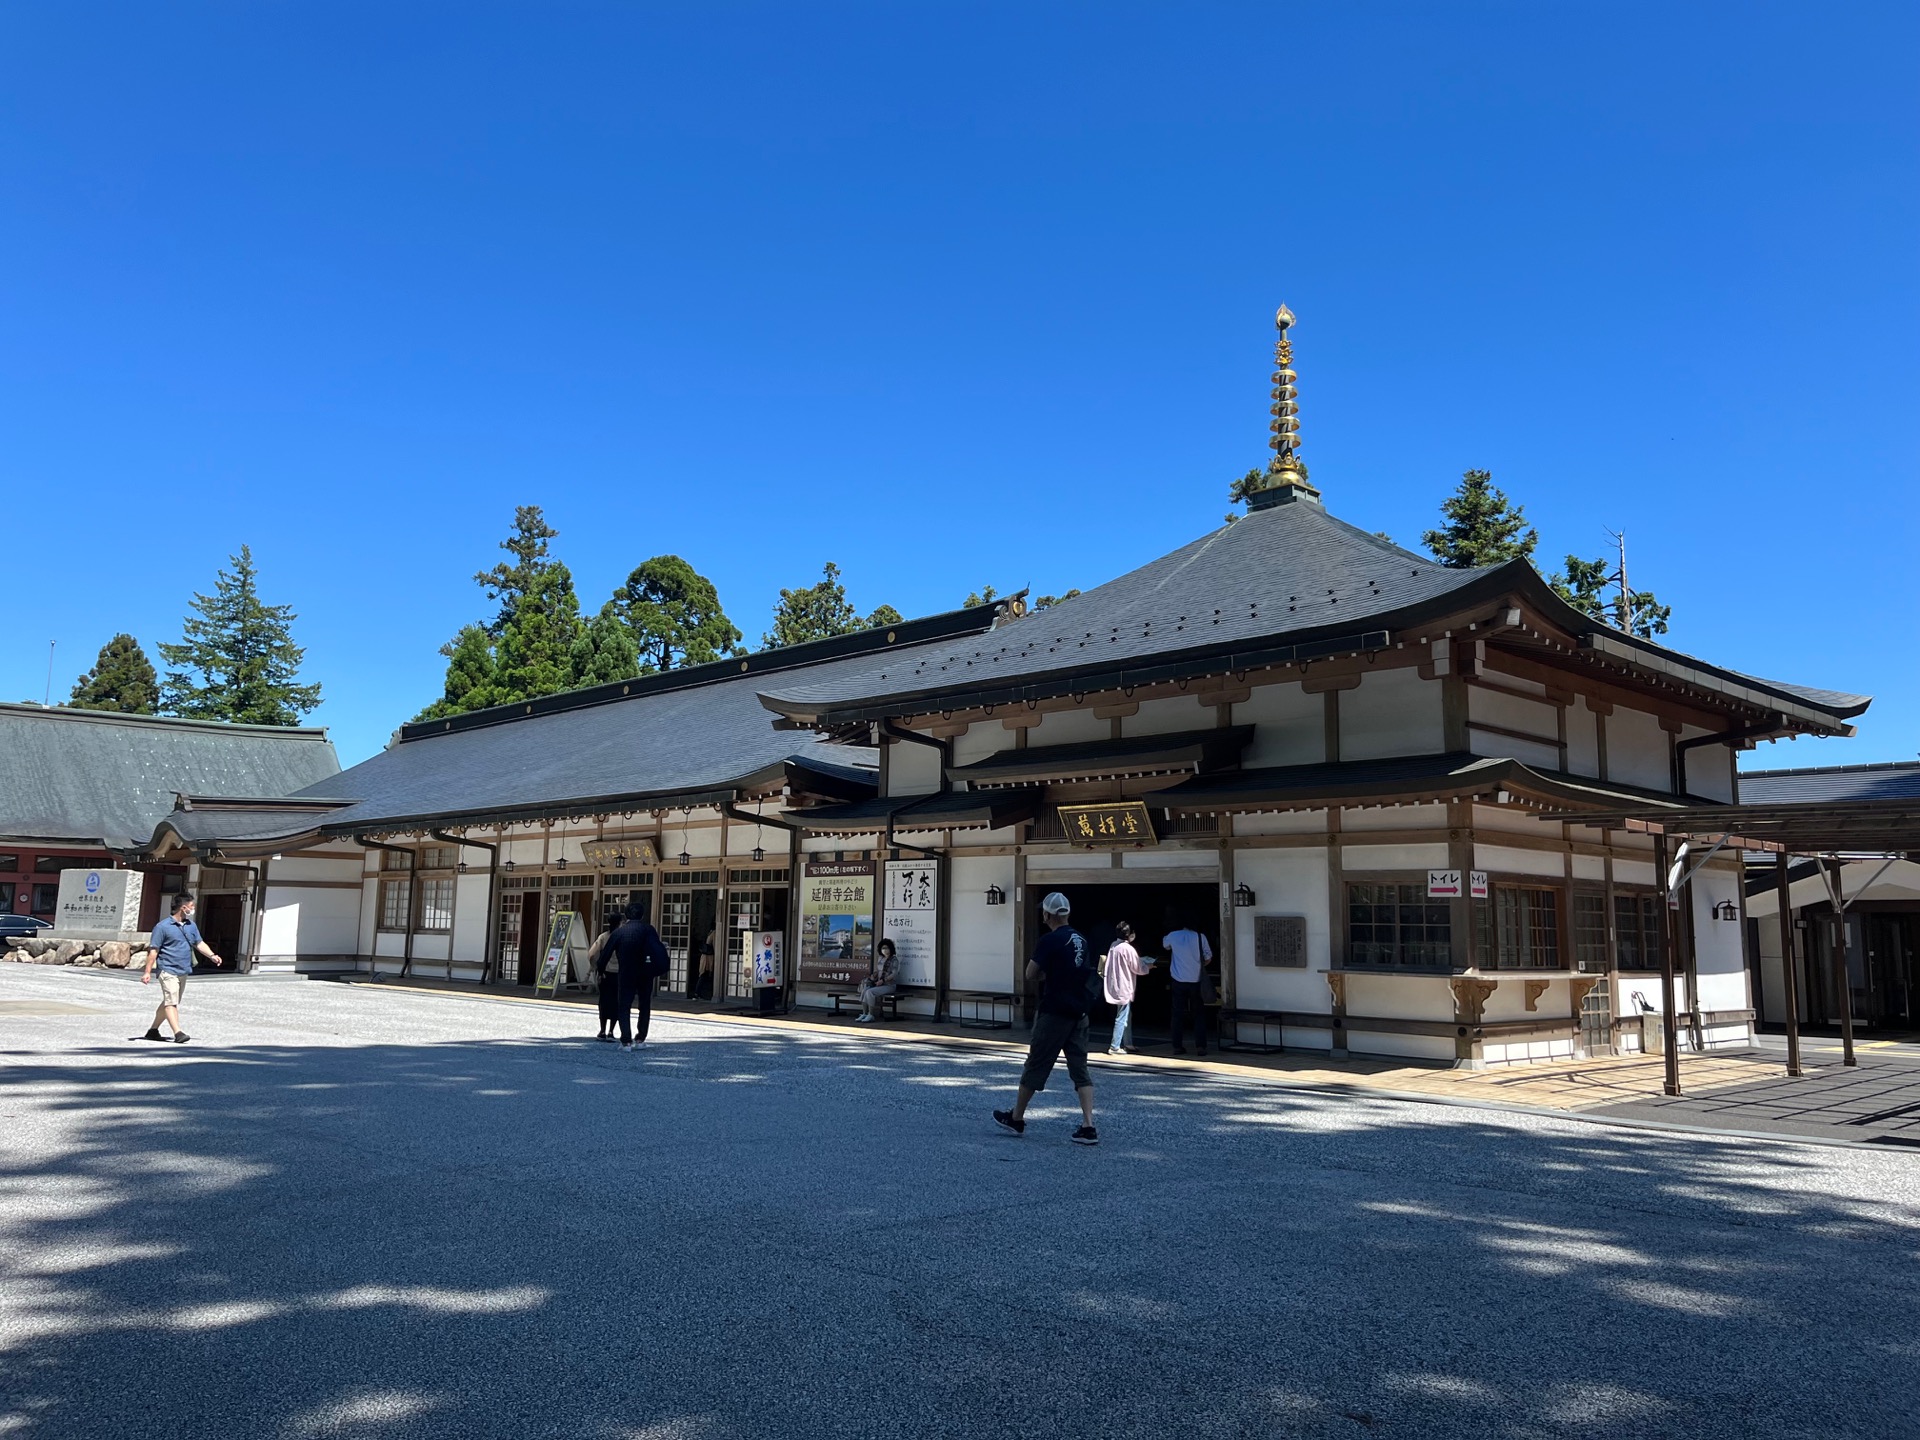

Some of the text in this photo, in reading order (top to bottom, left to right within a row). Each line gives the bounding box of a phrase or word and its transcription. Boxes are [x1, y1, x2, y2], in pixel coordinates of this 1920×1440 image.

[1431, 873, 1459, 884] トイレ
[1471, 873, 1486, 884] トイレ
[811, 887, 865, 902] 延暦寺会館
